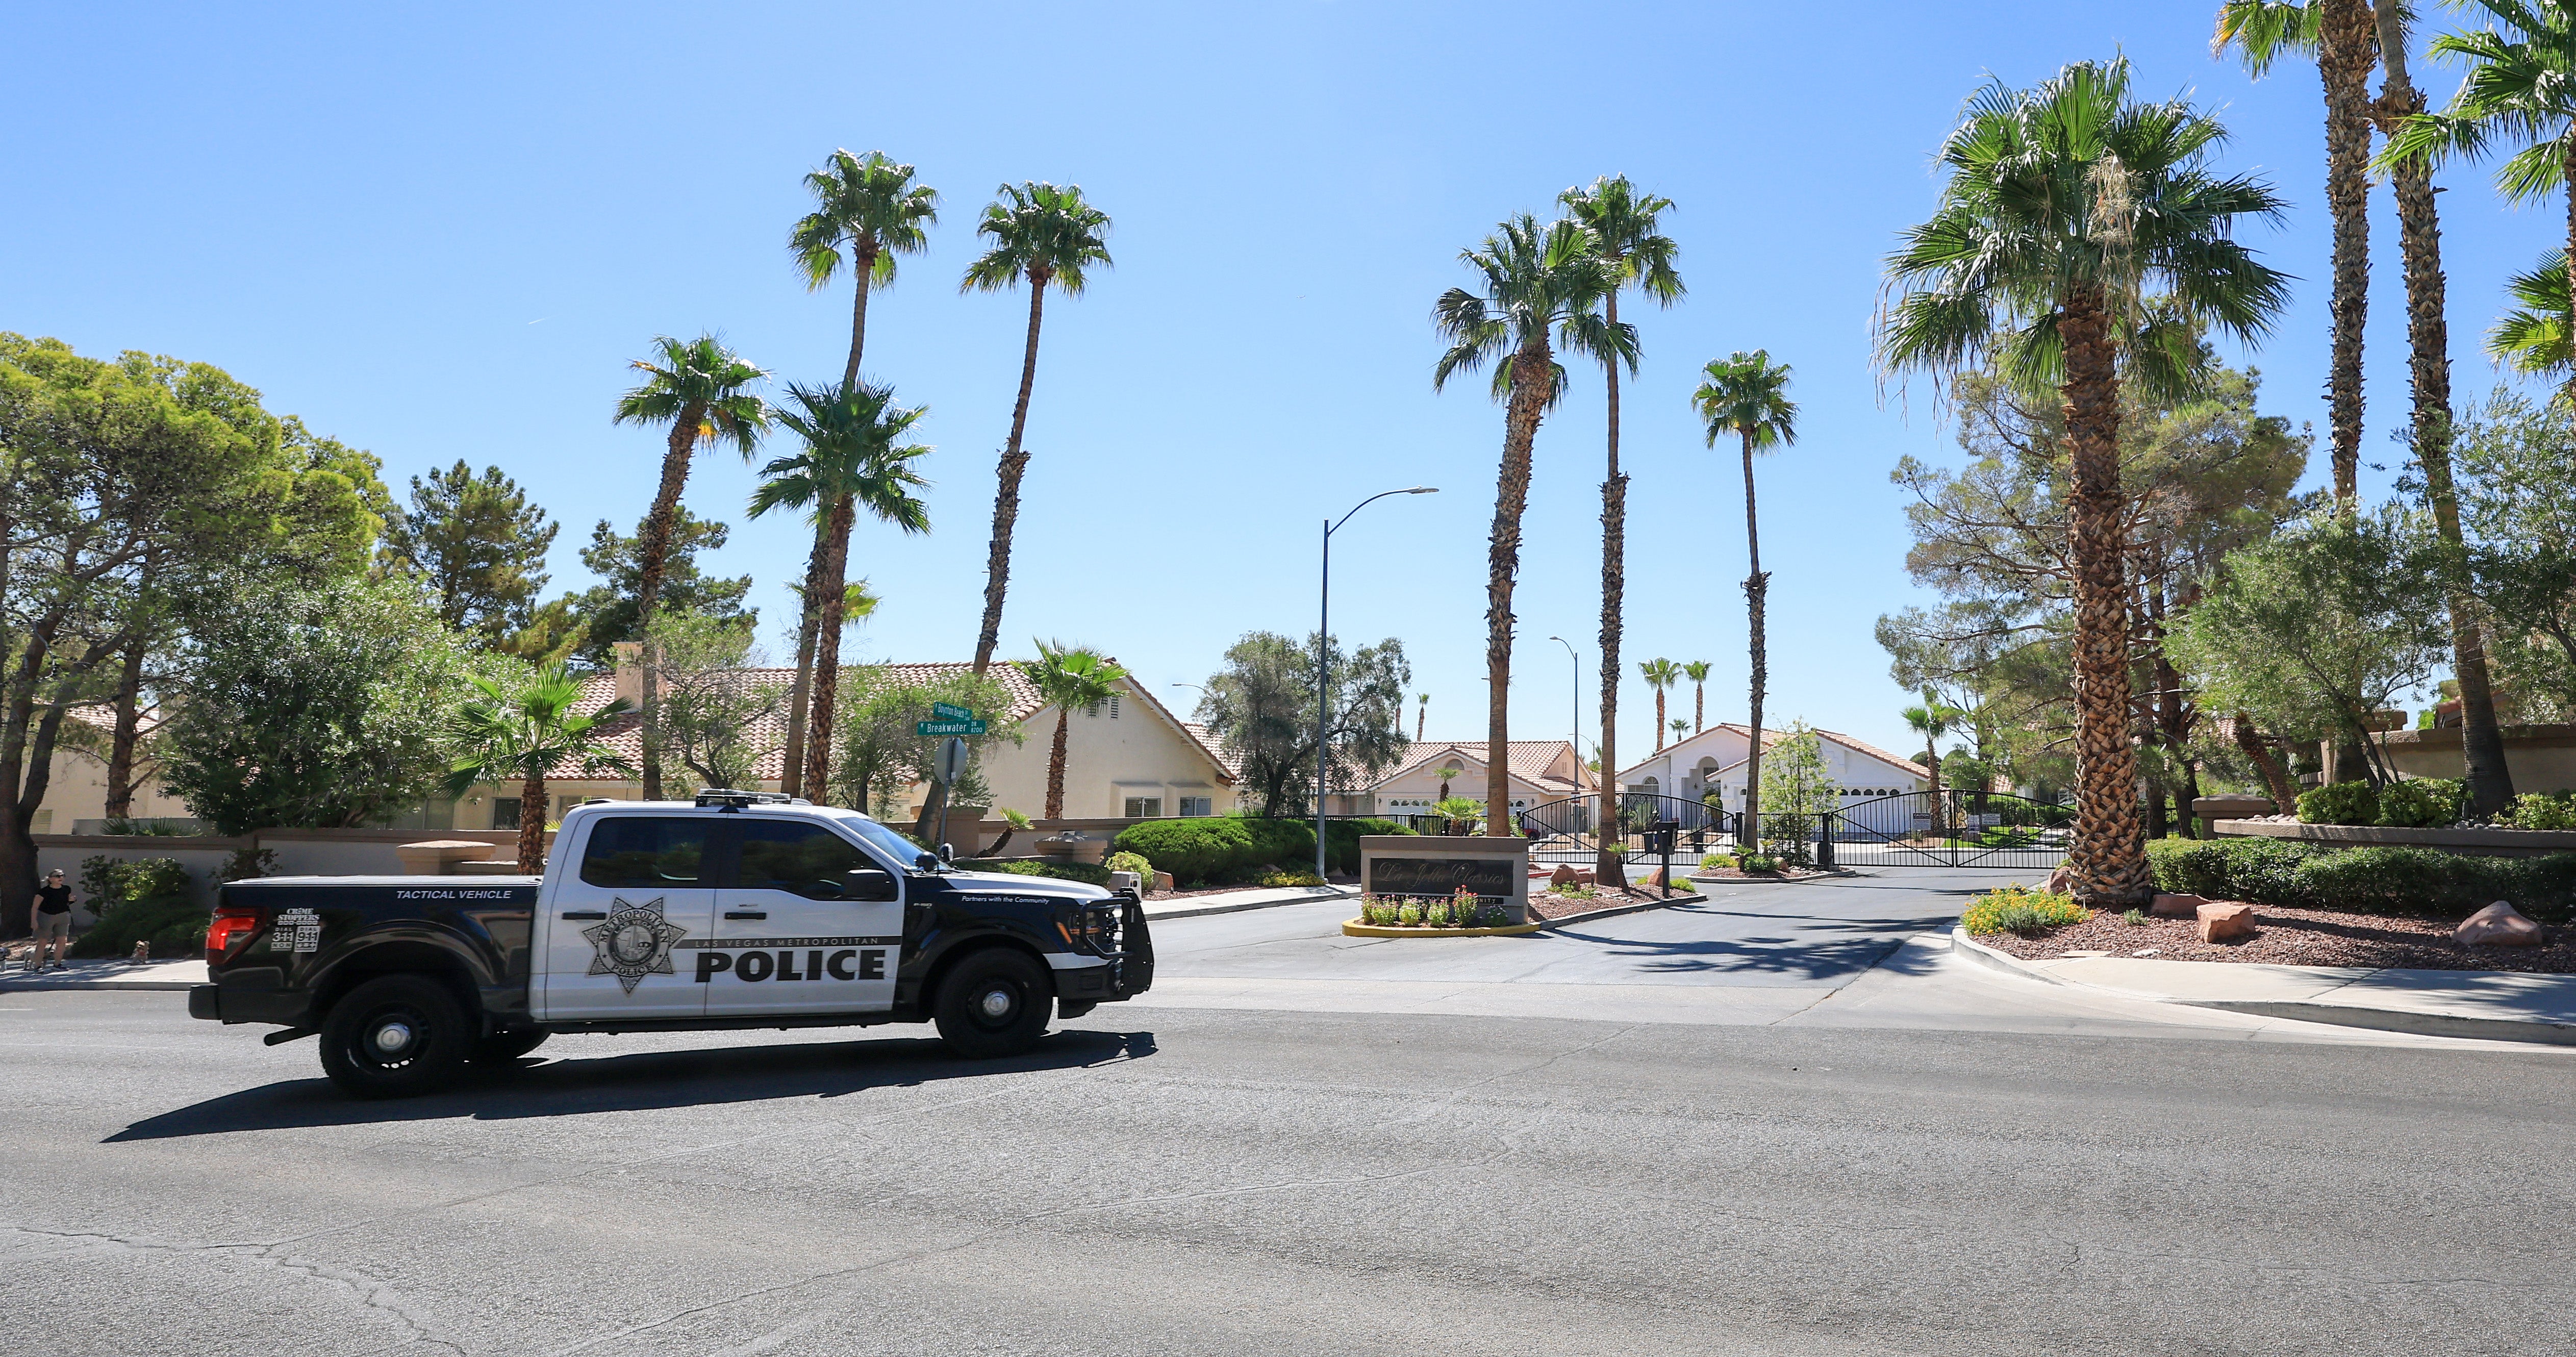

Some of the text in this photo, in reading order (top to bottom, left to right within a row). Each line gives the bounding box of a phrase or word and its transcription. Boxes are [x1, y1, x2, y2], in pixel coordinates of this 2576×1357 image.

[938, 704, 953, 715] Boynton
[954, 708, 964, 718] Beach
[927, 723, 967, 733] Breakwater
[1379, 862, 1505, 890] La Jolla Classics
[397, 891, 512, 899] TACTICAL VEHICLE
[600, 911, 668, 943] METROPOLITAN
[614, 920, 655, 934] LAS VEGAS
[776, 937, 878, 946] METROPOLITAN
[612, 963, 653, 975] POLICE
[695, 949, 886, 983] POLICE
